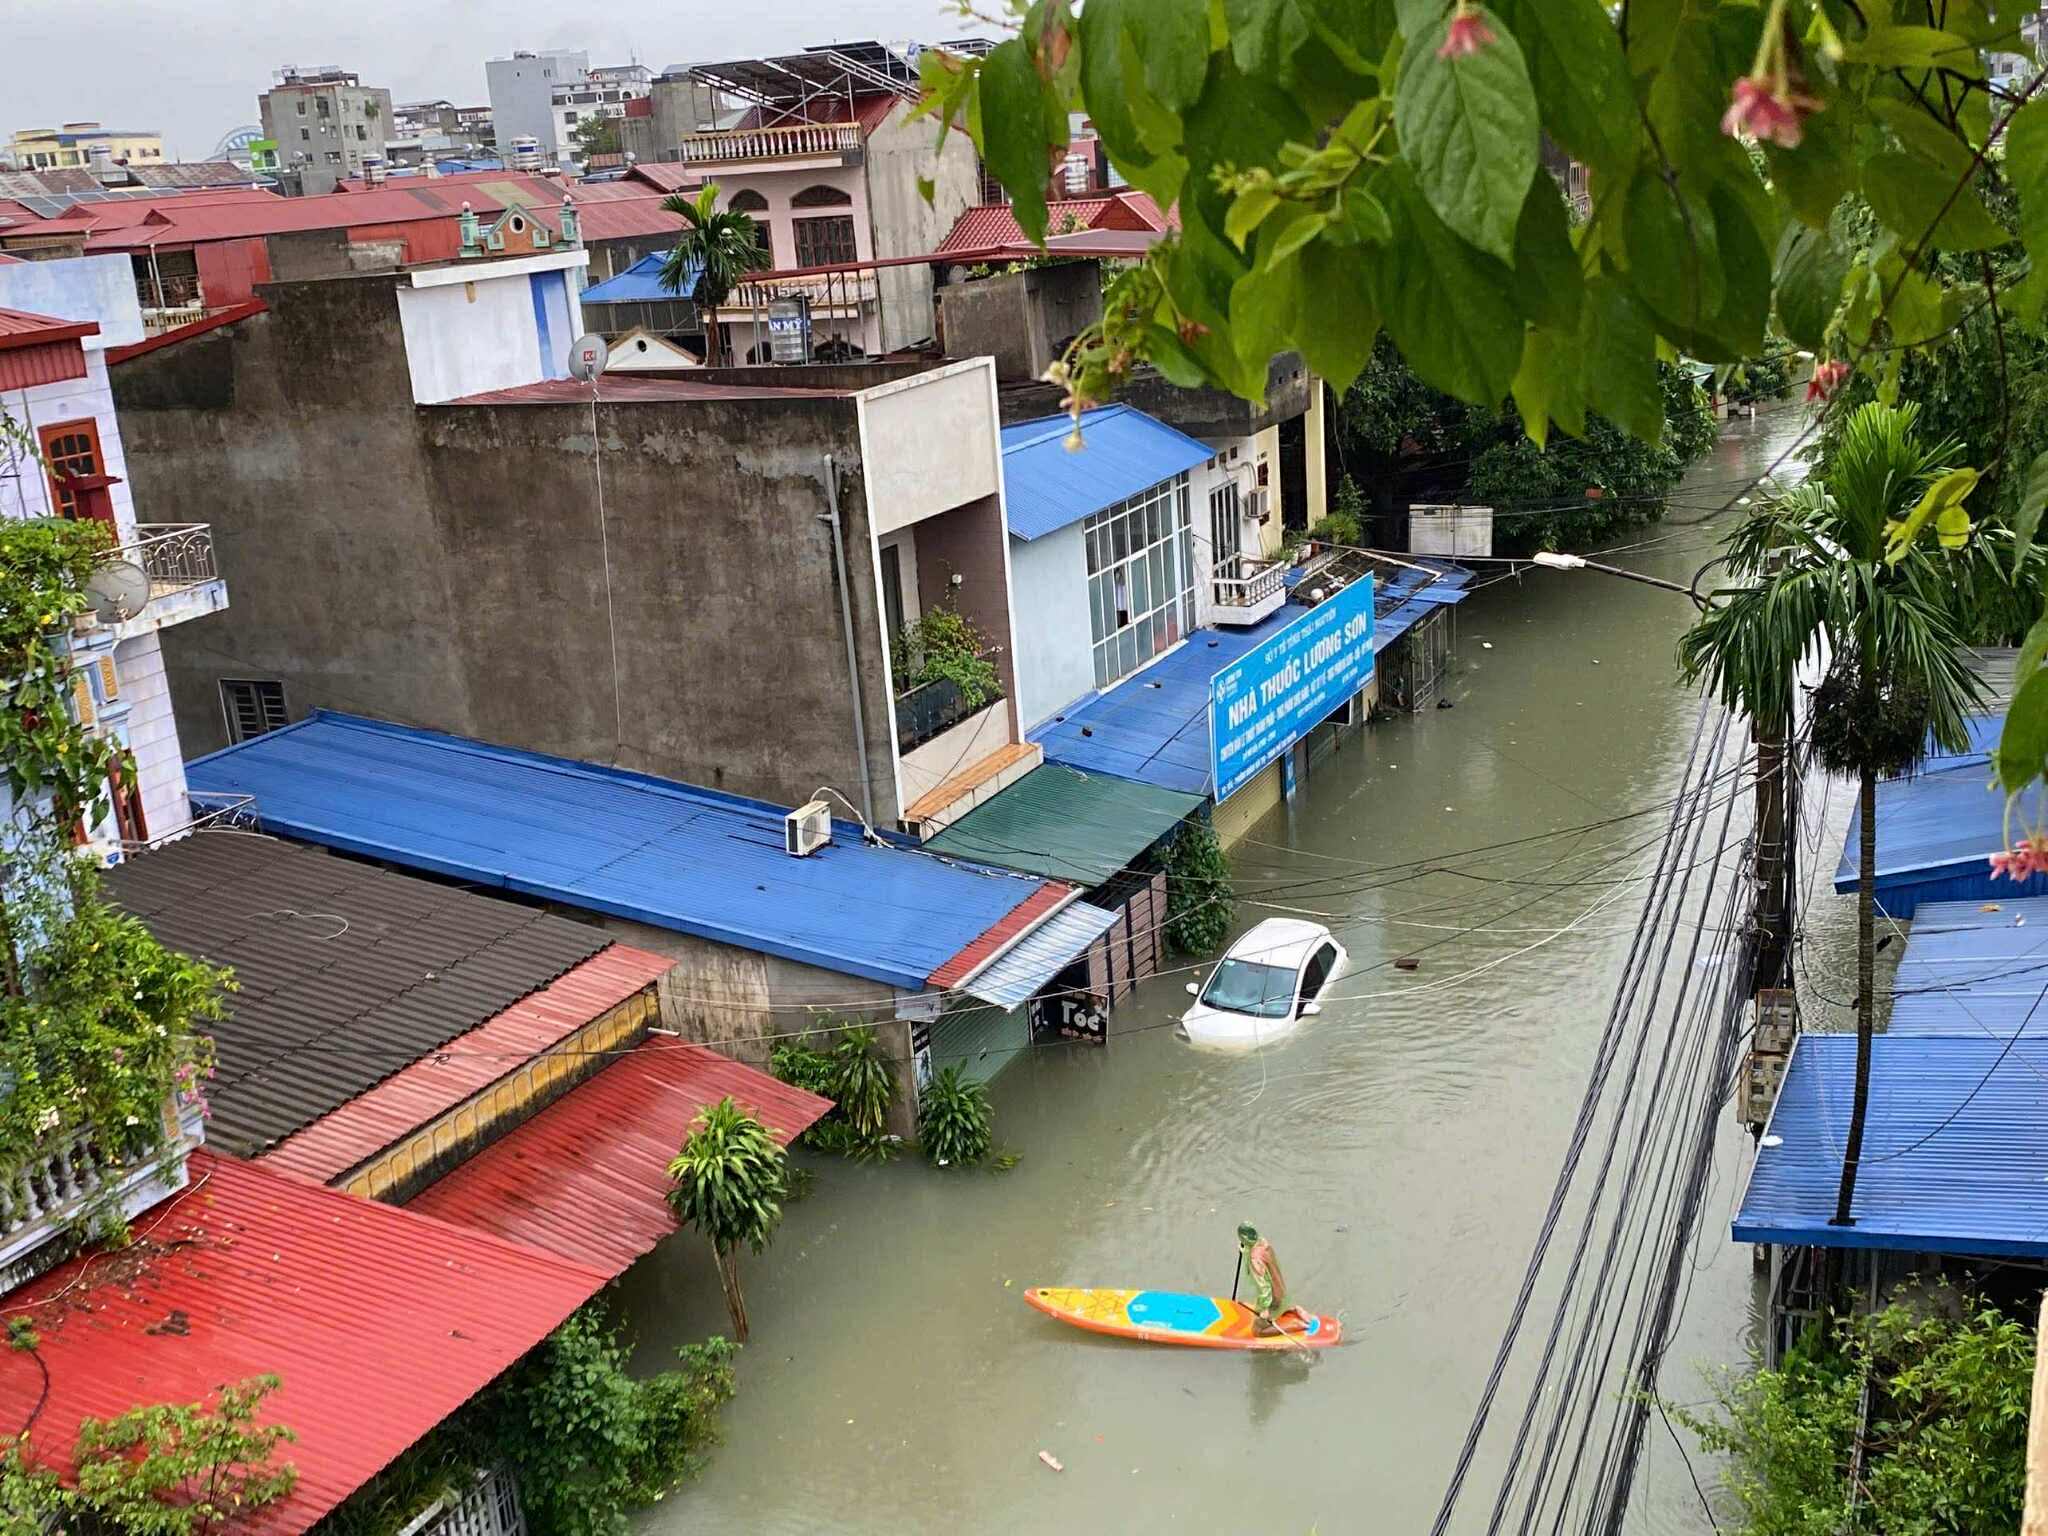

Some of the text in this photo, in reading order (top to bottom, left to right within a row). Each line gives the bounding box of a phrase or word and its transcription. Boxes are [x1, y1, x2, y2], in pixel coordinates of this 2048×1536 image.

[1229, 686, 1257, 730] NHÀ
[1260, 654, 1300, 705] THUỐC
[1303, 630, 1341, 675] LƯƠNG
[1344, 611, 1366, 645] SƠN
